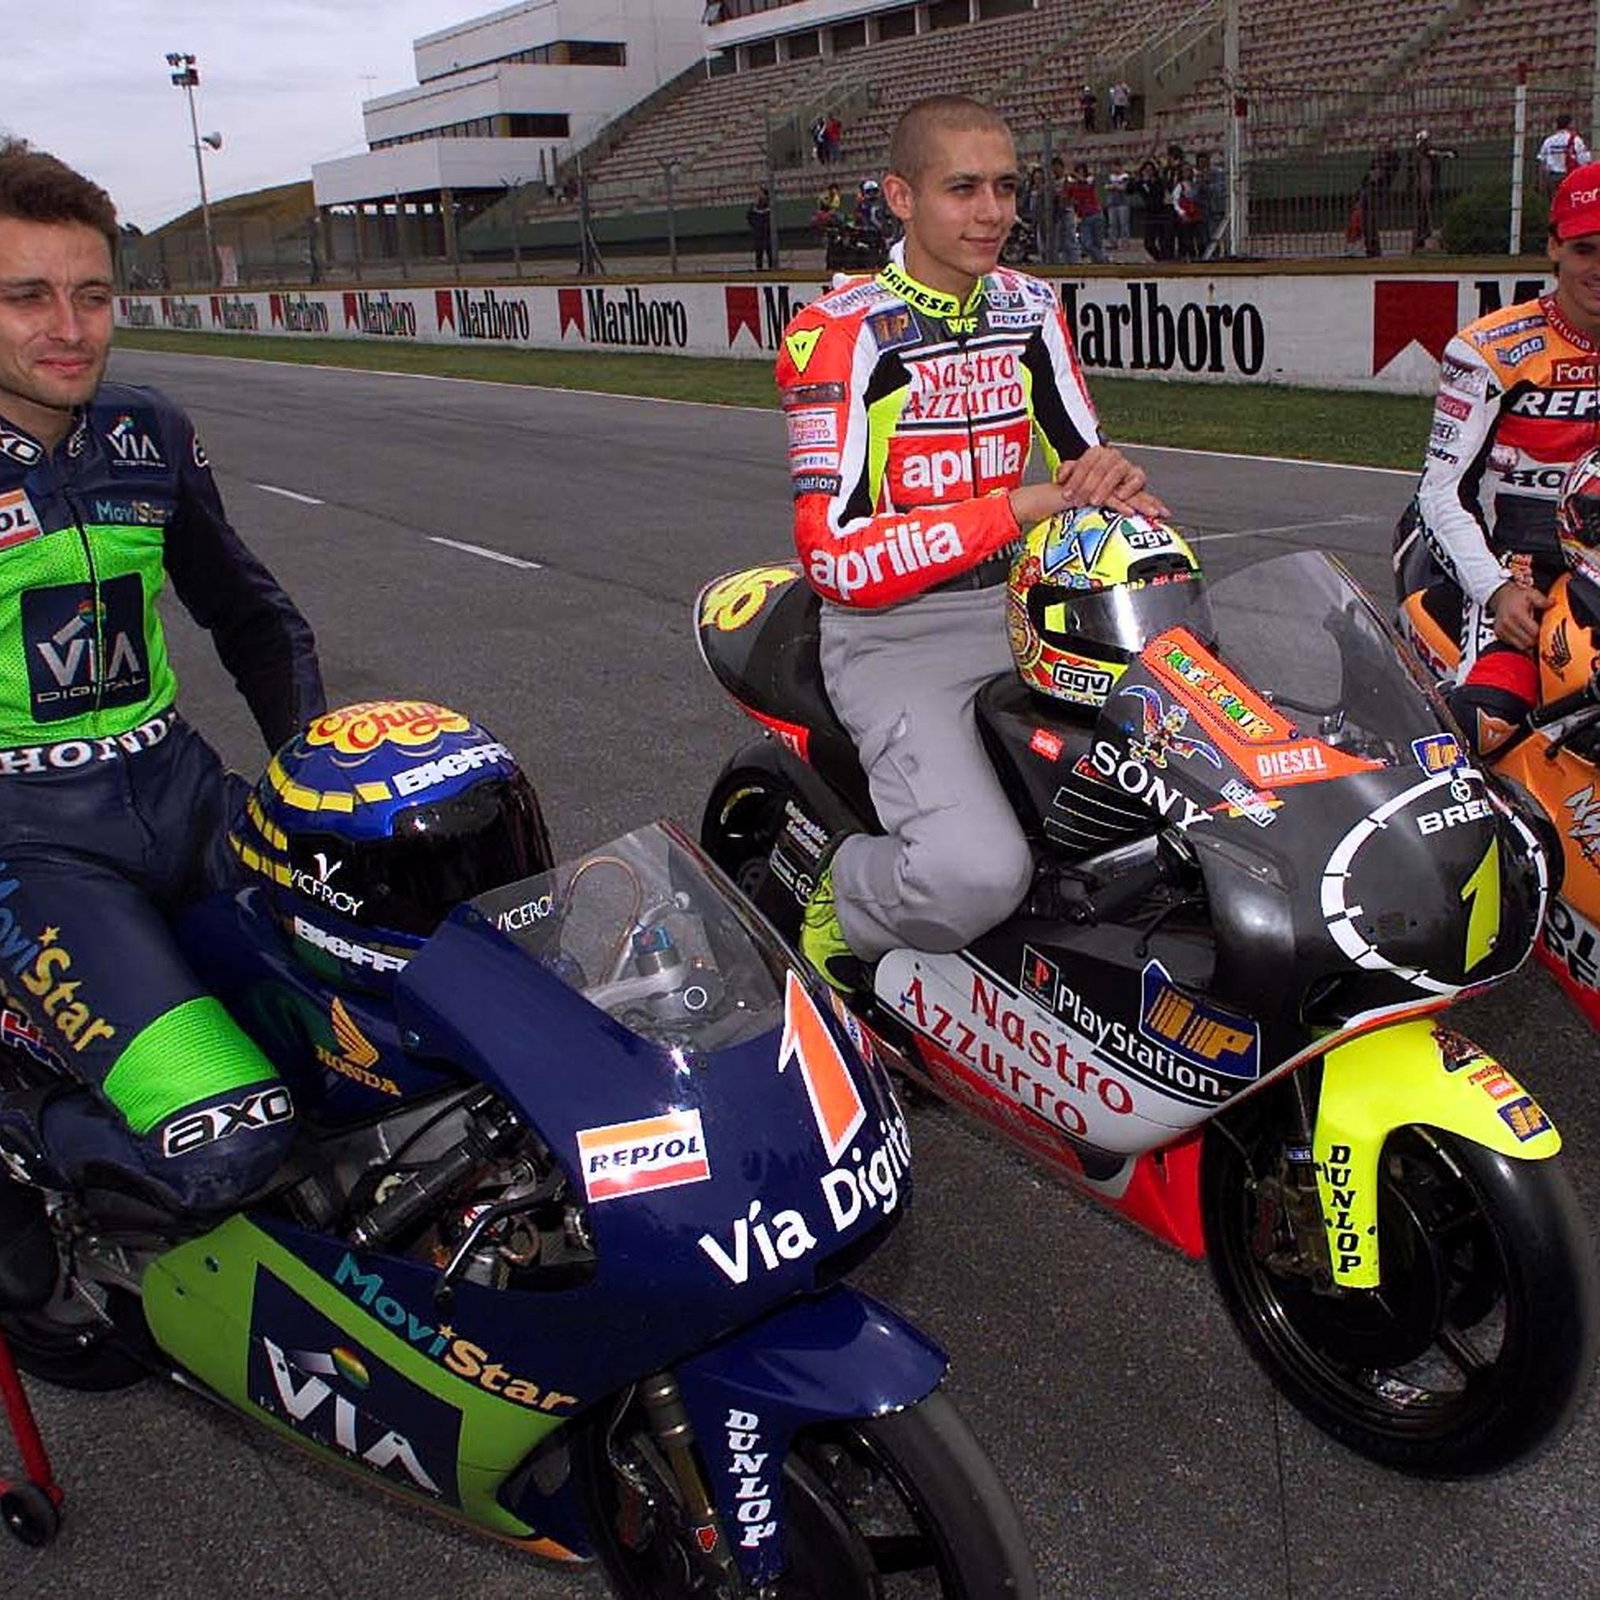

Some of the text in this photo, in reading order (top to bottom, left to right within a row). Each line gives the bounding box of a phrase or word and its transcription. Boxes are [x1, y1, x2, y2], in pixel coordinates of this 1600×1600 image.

[357, 291, 417, 337] Marlboro
[454, 289, 531, 341] Marlboro
[586, 287, 690, 349] Marlboro
[991, 312, 1046, 326] DUNLO
[913, 352, 1017, 395] Nastro
[900, 382, 1024, 421] Azzurro
[105, 433, 160, 460] VIA
[901, 434, 1022, 498] aprilia
[1500, 468, 1567, 490] HO
[95, 500, 174, 525] MoviSta
[810, 519, 966, 602] aprilia
[1129, 531, 1173, 550] agv
[36, 632, 141, 687] VIA
[1058, 669, 1110, 697] agv
[36, 674, 146, 704] DIGITAL
[0, 712, 177, 776] HOND
[1256, 745, 1328, 778] DIESEL
[1090, 740, 1214, 832] SONY
[287, 867, 365, 916] VICEROY
[488, 892, 556, 933] VICERO
[1460, 834, 1501, 974] 1
[777, 967, 868, 1168] 1
[898, 976, 1088, 1137] Azzurro
[970, 971, 1134, 1115] Nastro
[1058, 984, 1219, 1098] PlayStation
[314, 1044, 402, 1097] HONDA
[163, 1086, 294, 1158] axo
[588, 1134, 702, 1175] REPSOL
[698, 1115, 913, 1285] Vía Digita
[1328, 1144, 1362, 1274] DUNLOP
[331, 1250, 581, 1412] MoviStar
[262, 1335, 444, 1499] VIA
[724, 1408, 777, 1548] DUNLOP
